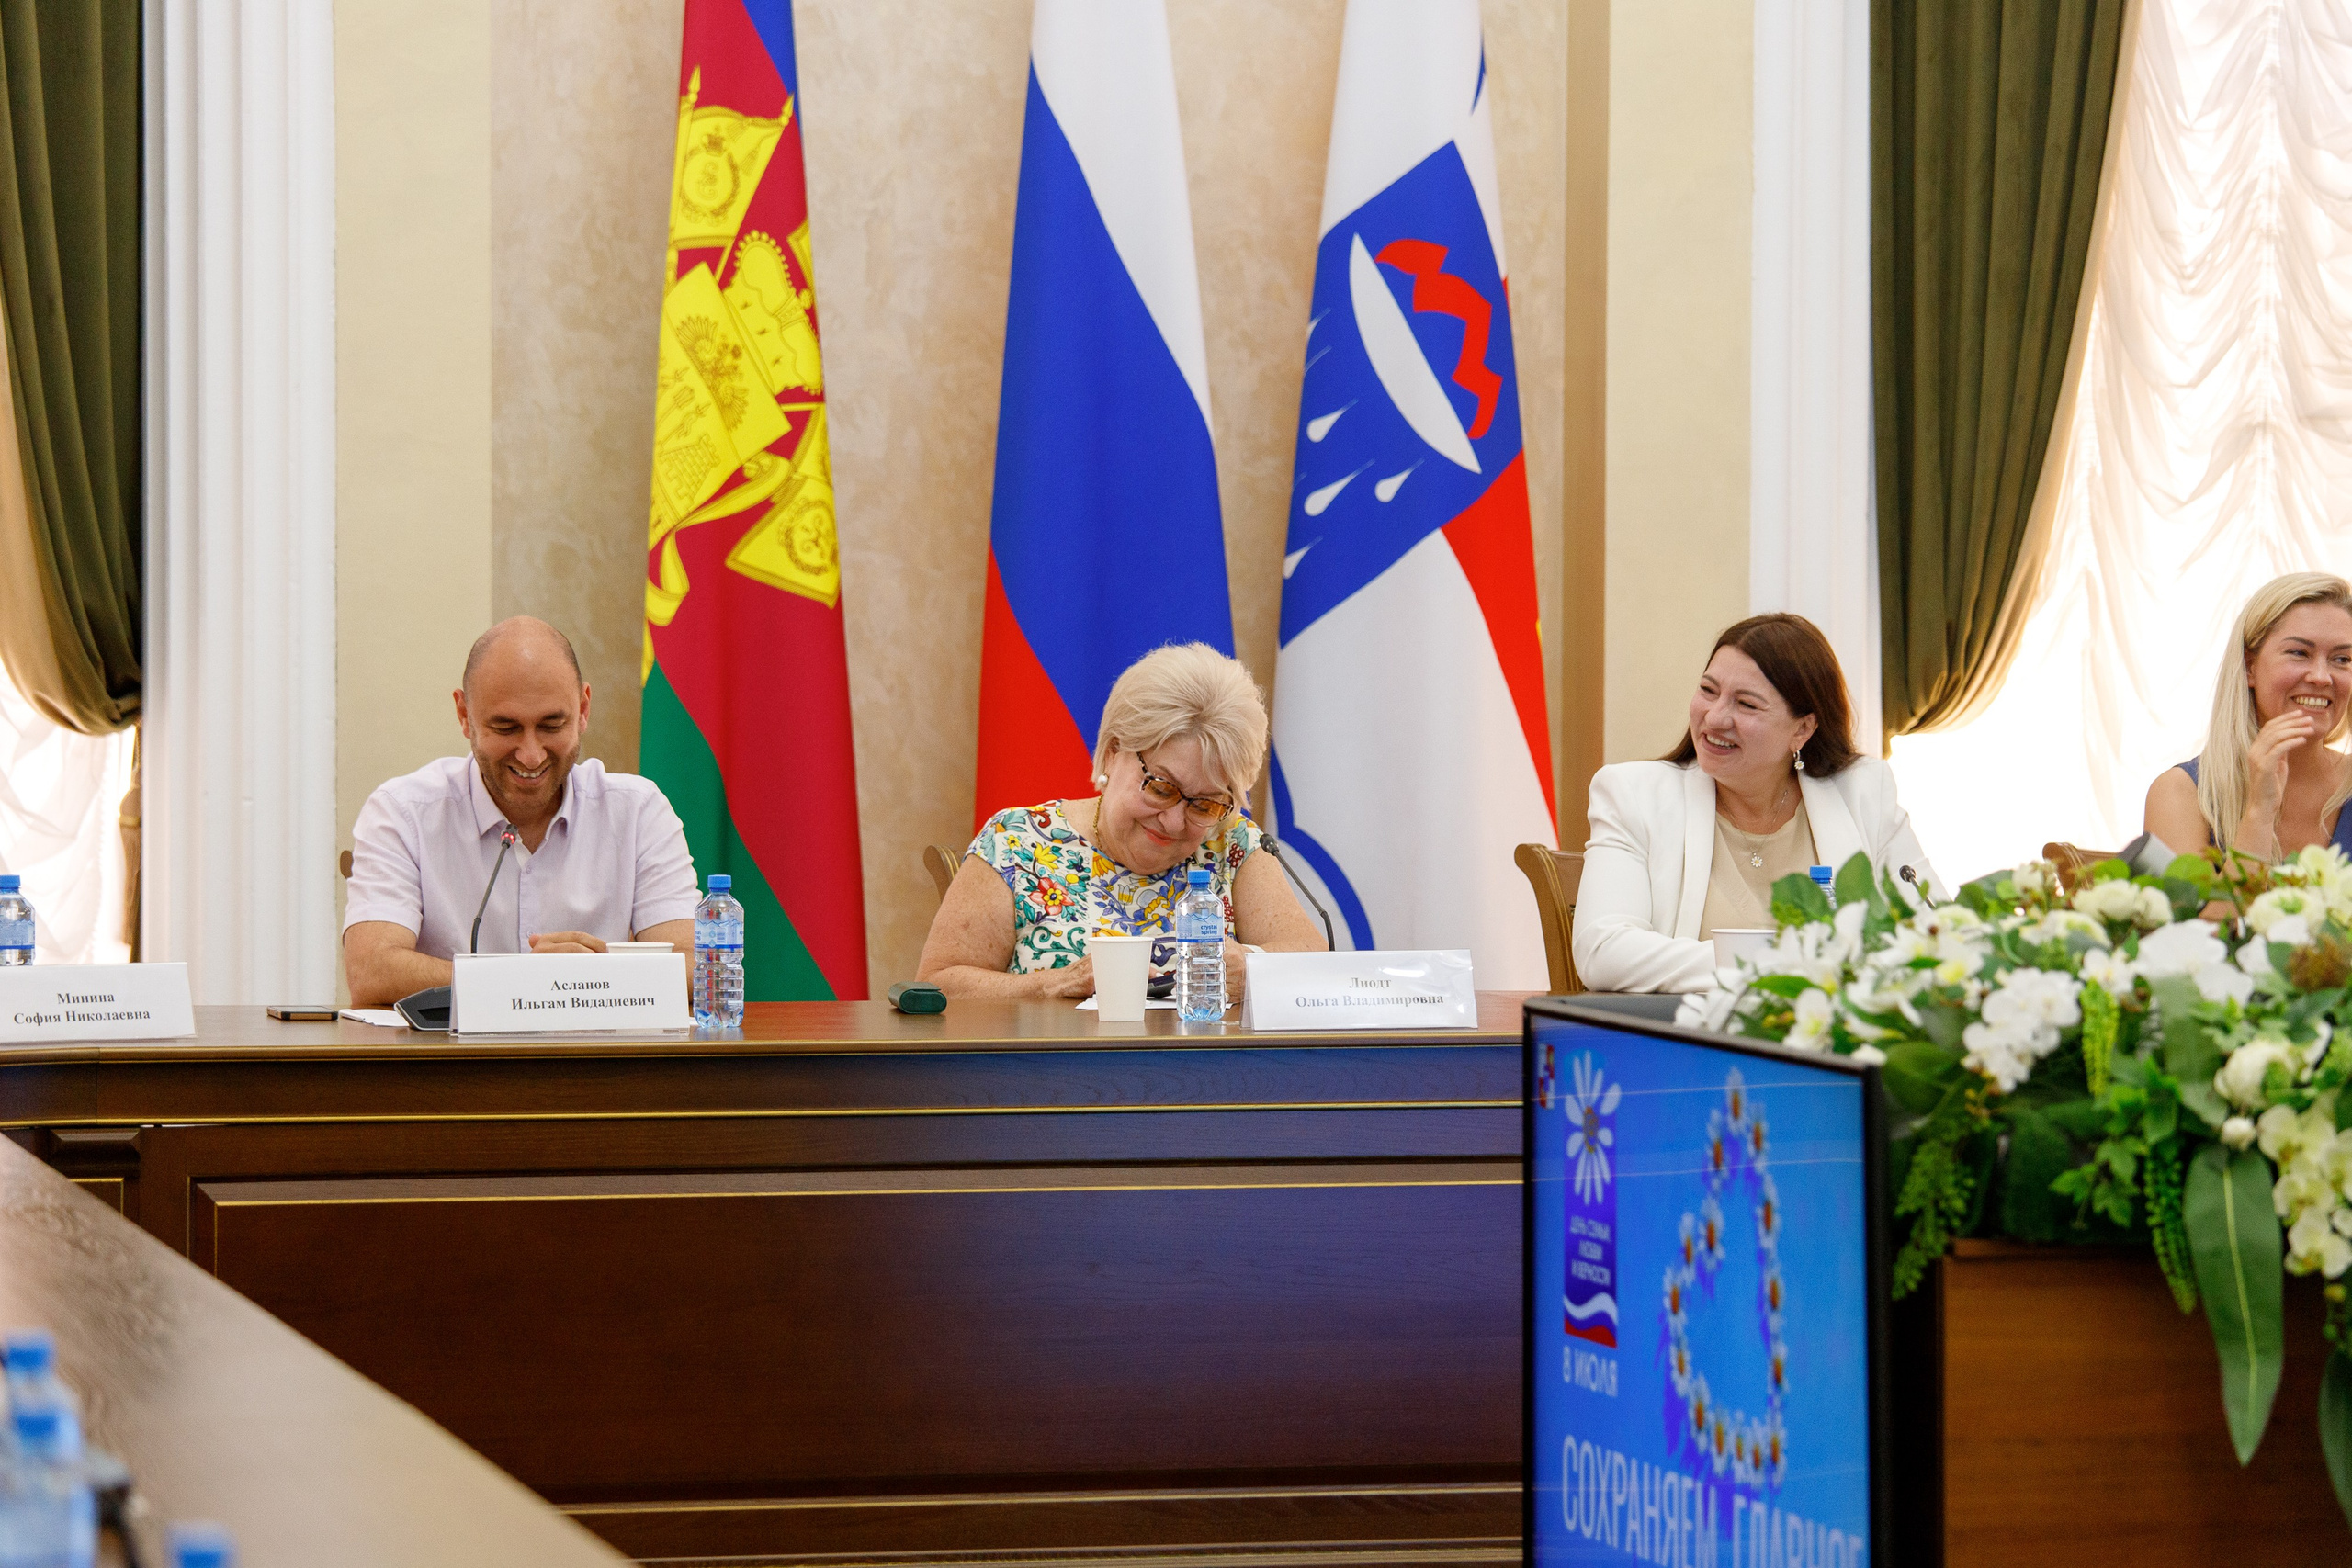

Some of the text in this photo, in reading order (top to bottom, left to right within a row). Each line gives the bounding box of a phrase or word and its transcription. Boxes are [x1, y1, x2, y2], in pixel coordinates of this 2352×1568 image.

[550, 980, 611, 992] Асланов
[1348, 977, 1392, 989] Лиодт
[56, 992, 116, 1005] Минина
[511, 995, 656, 1010] Ильгам Видадиевич
[1295, 994, 1444, 1010] Ольга Владимировна
[13, 1010, 152, 1027] София Николаевна
[1563, 1345, 1571, 1383] 8
[1563, 1434, 1718, 1568] СОХРАНЯЕМ
